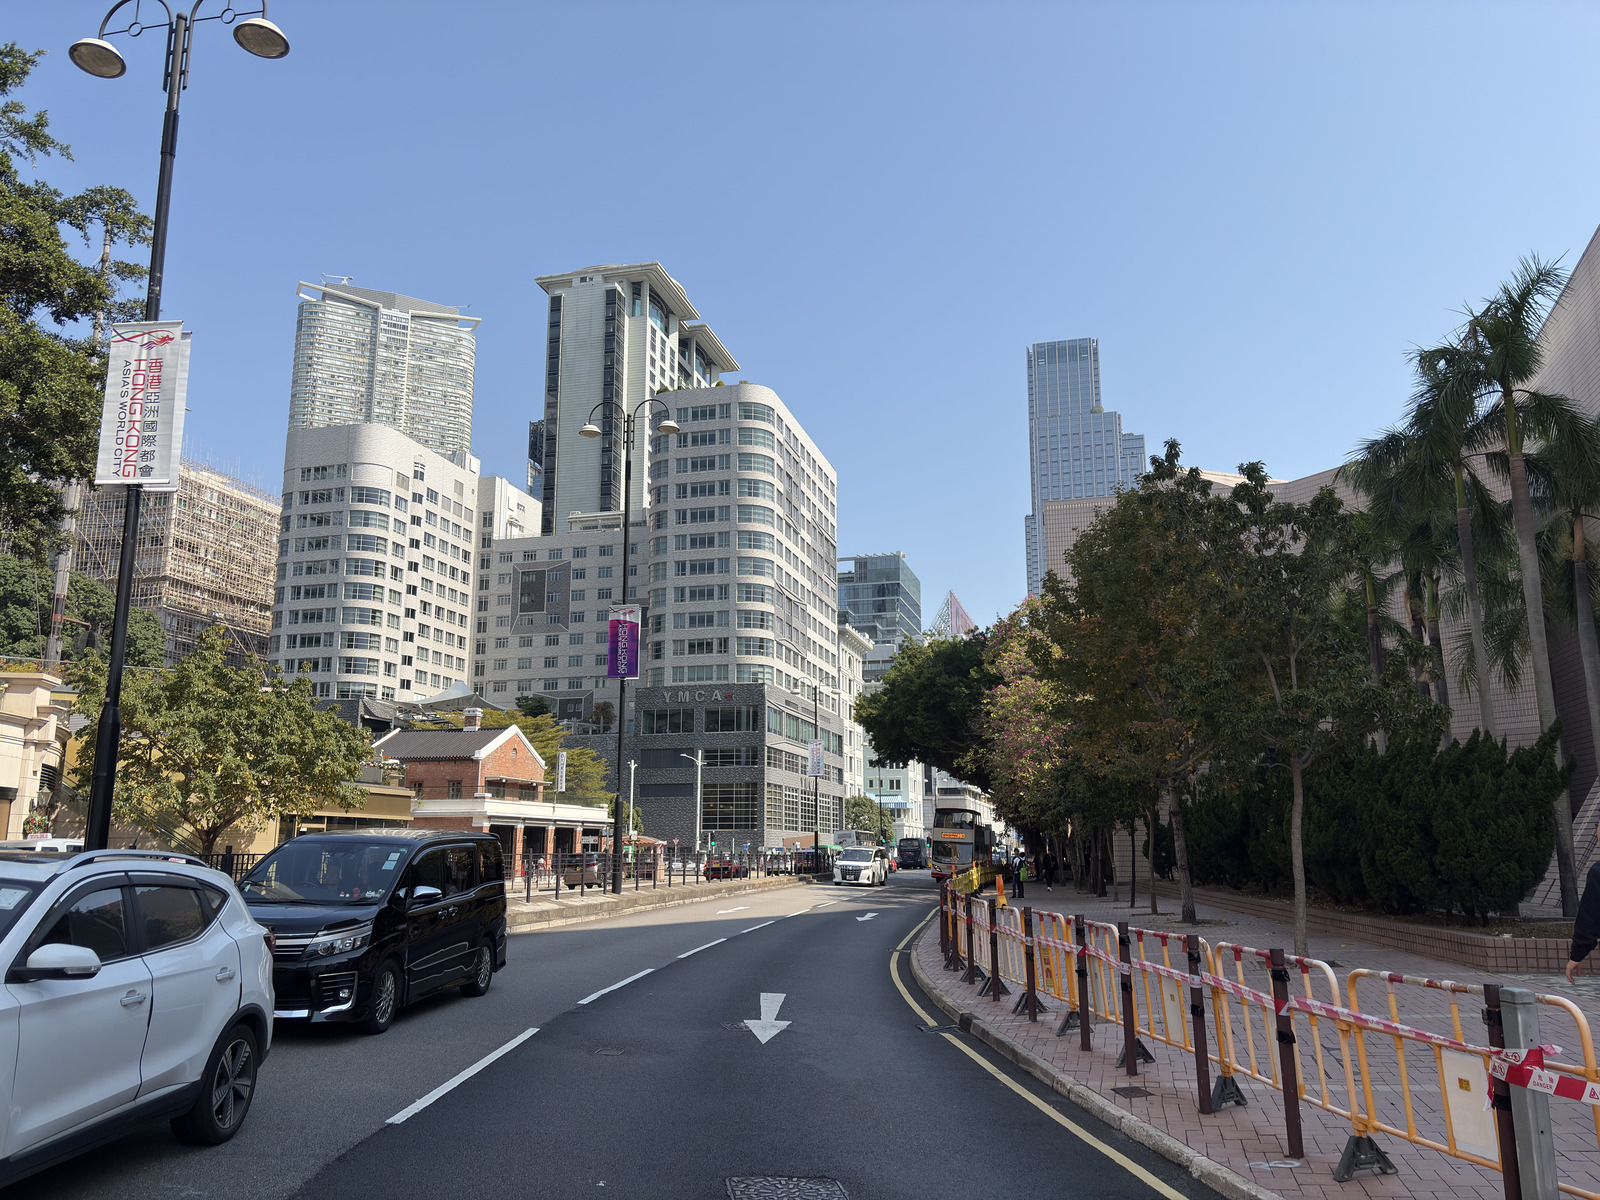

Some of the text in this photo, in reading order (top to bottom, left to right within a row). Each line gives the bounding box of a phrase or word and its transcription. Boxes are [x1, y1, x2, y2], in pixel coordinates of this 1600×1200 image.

[112, 360, 131, 477] ASIA'S WORLD CITY
[122, 358, 147, 478] HONG KONG
[138, 357, 163, 477] 香港亞洲國際都會
[663, 690, 722, 703] YMCA
[1532, 1080, 1553, 1090] DANGER
